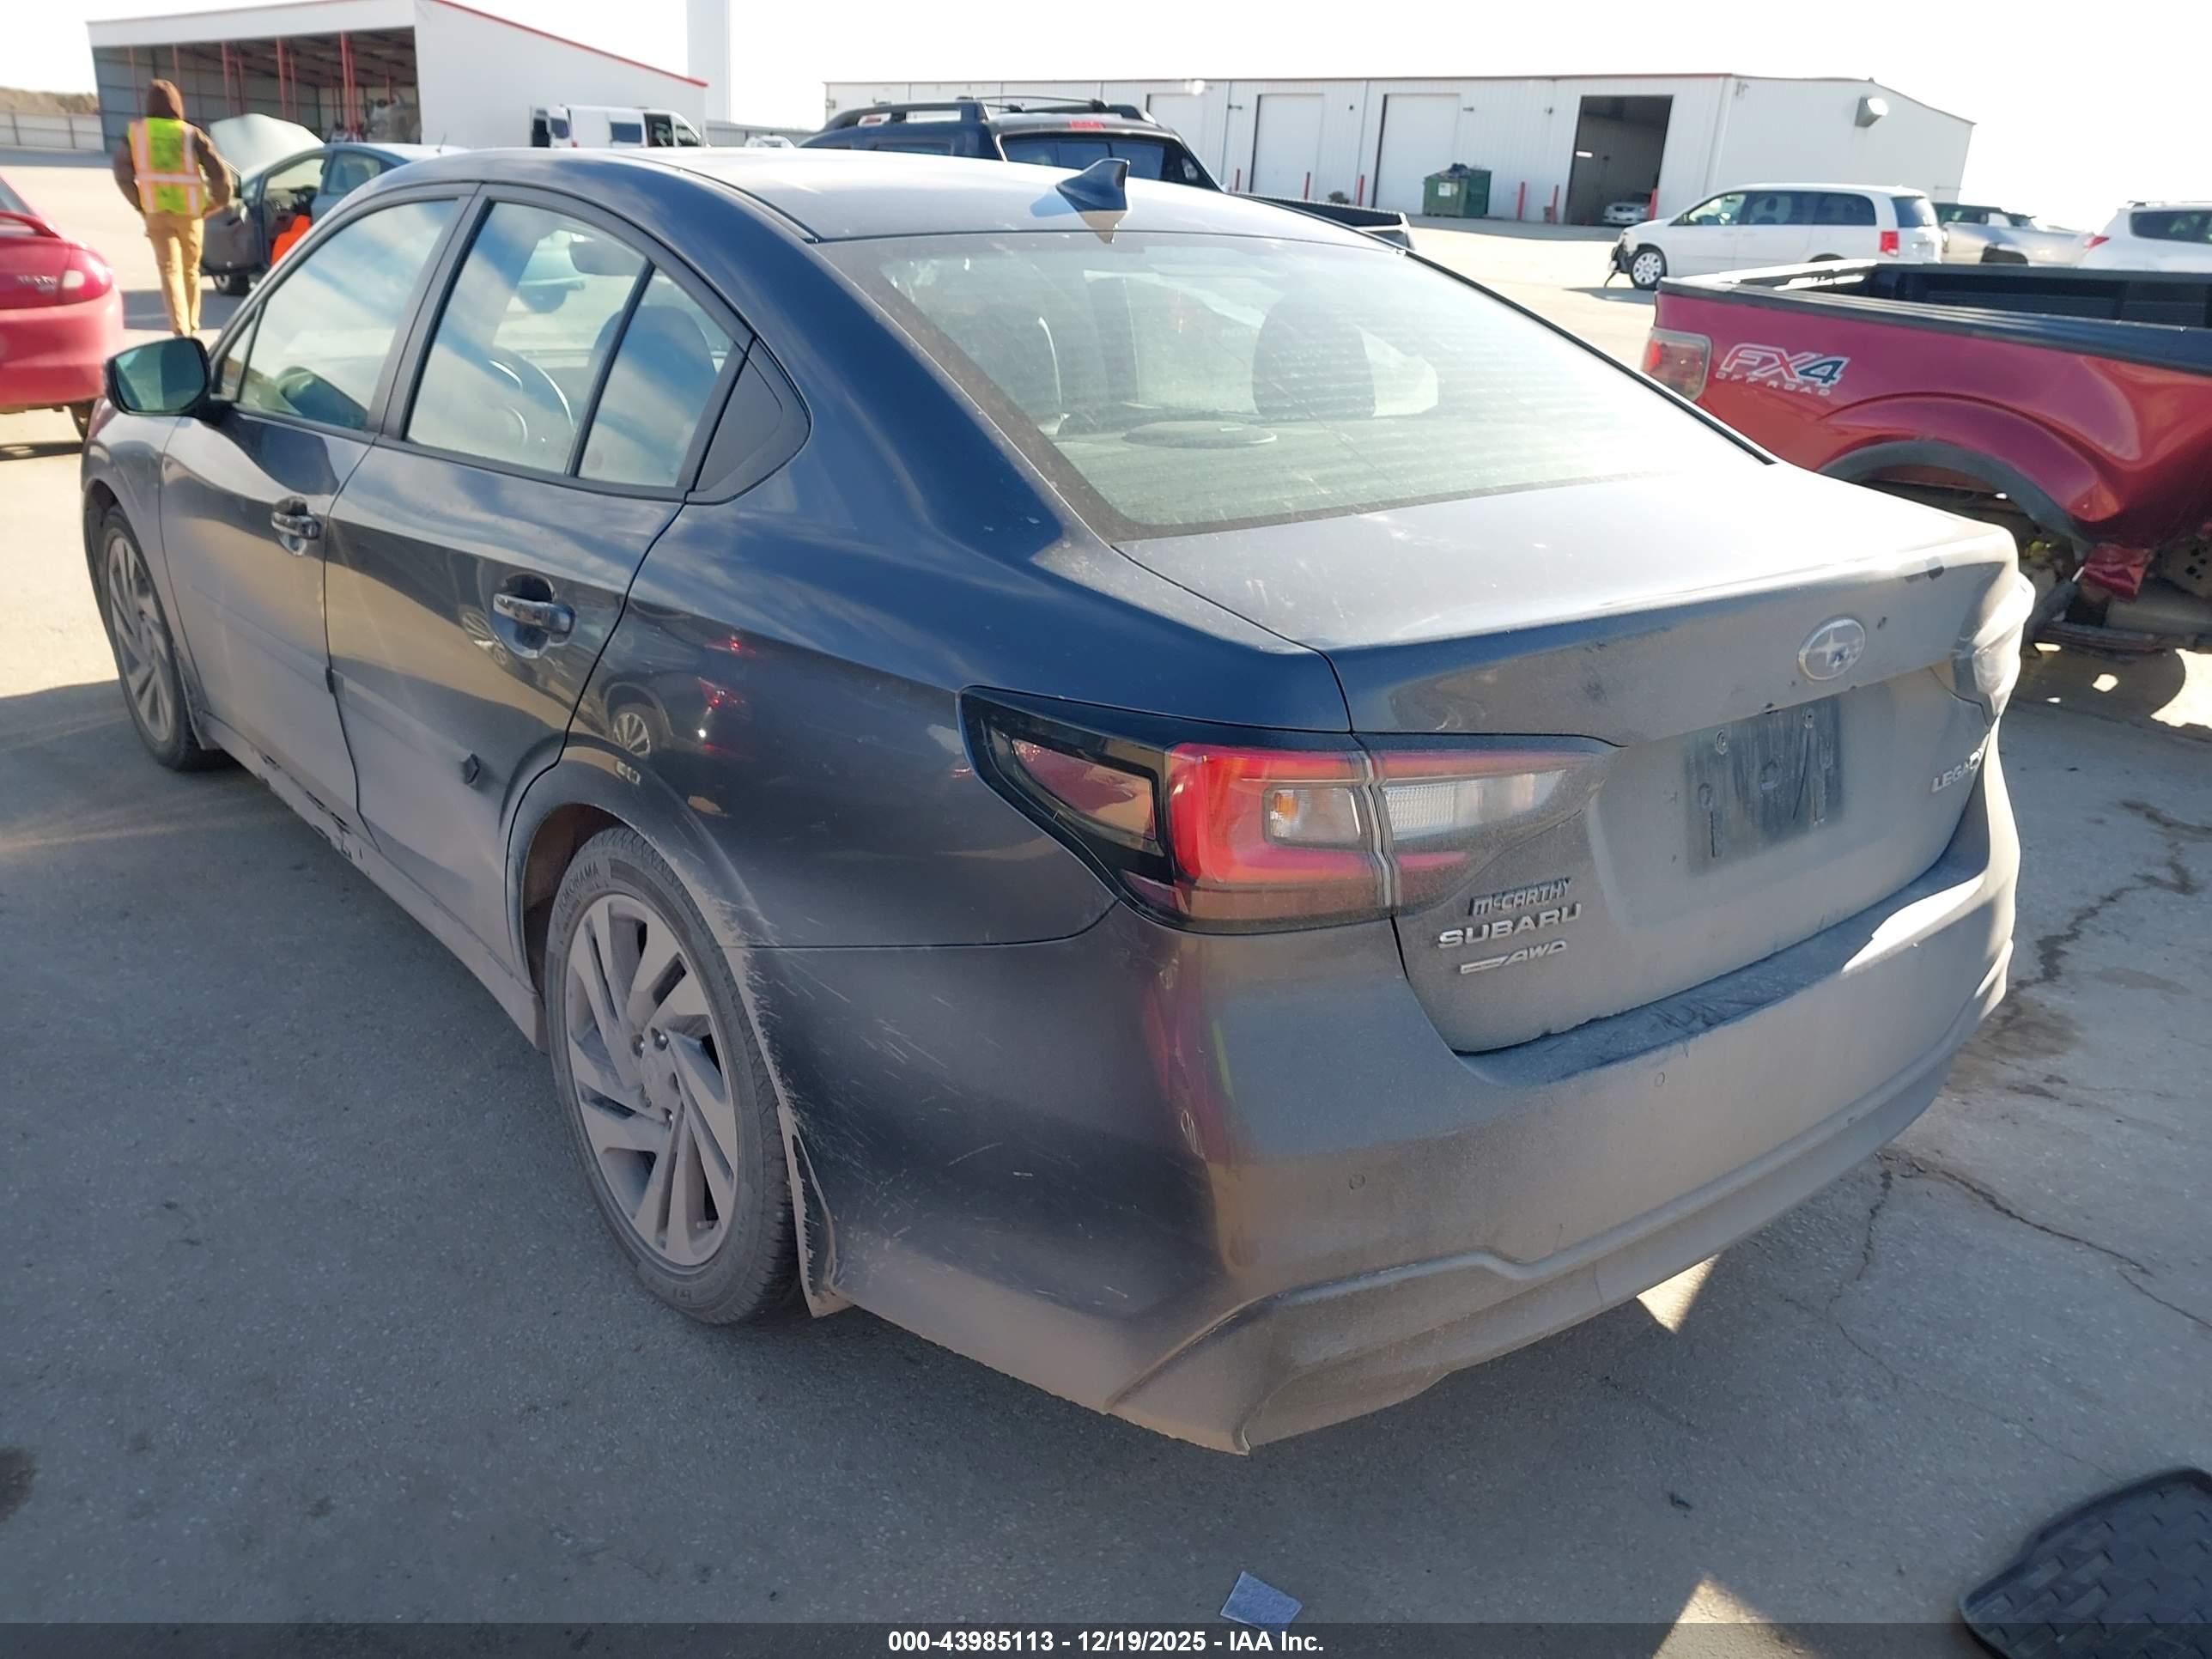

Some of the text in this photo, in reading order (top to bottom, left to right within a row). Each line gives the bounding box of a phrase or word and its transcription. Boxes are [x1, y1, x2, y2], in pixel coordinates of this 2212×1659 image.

[1718, 343, 1850, 386] FX4
[1715, 371, 1831, 396] OFF ROAD
[1437, 902, 1582, 949] SUBARU
[1504, 939, 1567, 966] AWD
